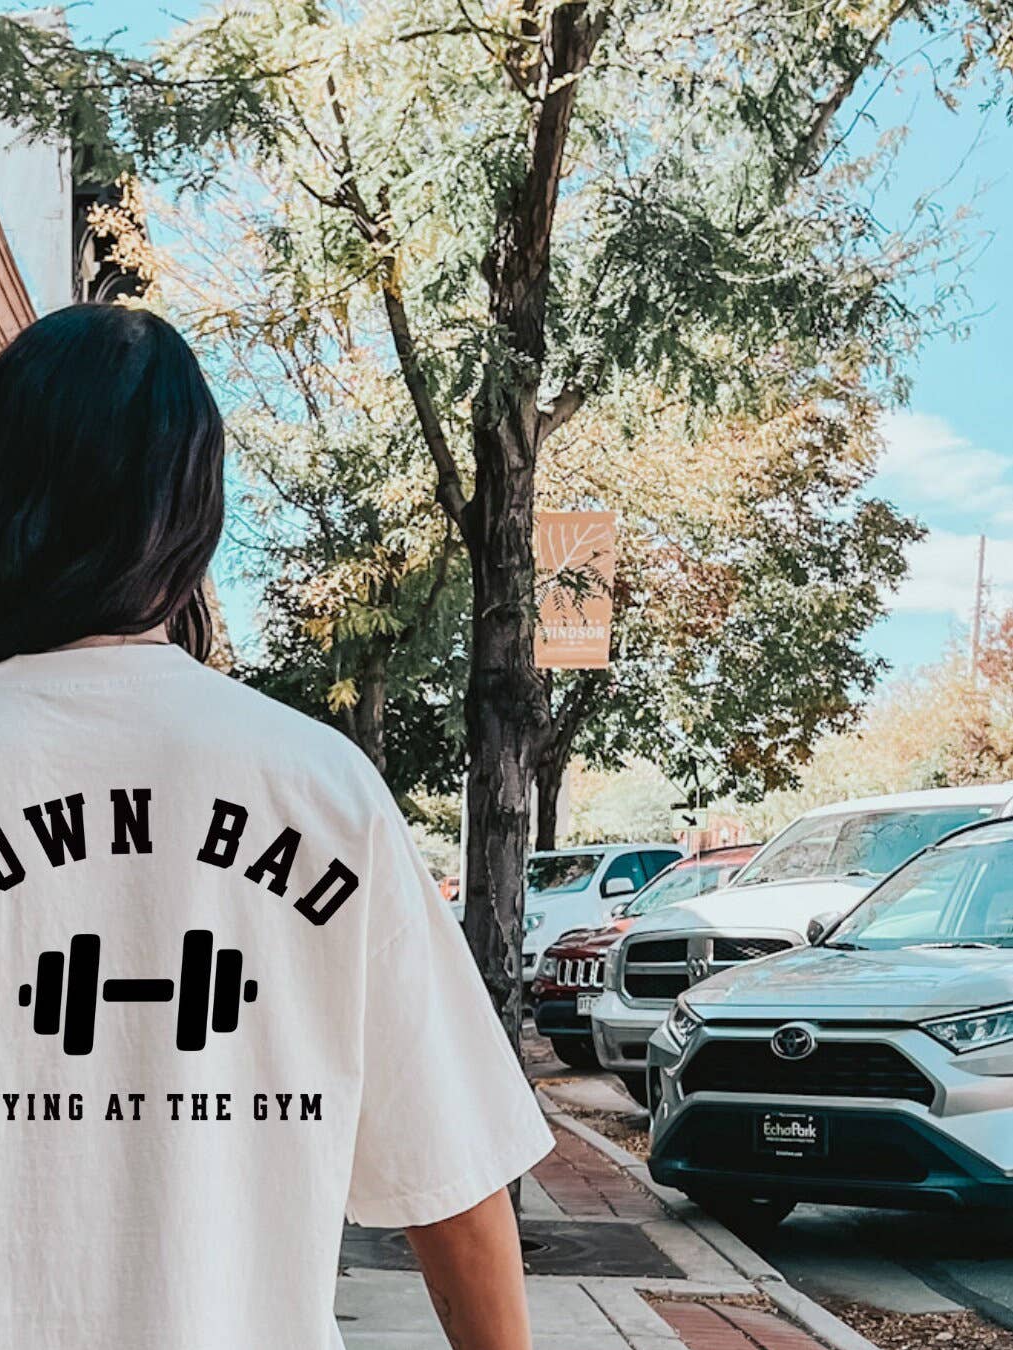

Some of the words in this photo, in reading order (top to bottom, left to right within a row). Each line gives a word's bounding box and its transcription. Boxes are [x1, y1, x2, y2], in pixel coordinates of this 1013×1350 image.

[540, 626, 605, 640] WINDSOR
[197, 798, 359, 926] BAD
[105, 1094, 145, 1120] AT
[167, 1094, 230, 1120] THE
[254, 1094, 322, 1120] GYM
[763, 1121, 817, 1138] EchoPark
